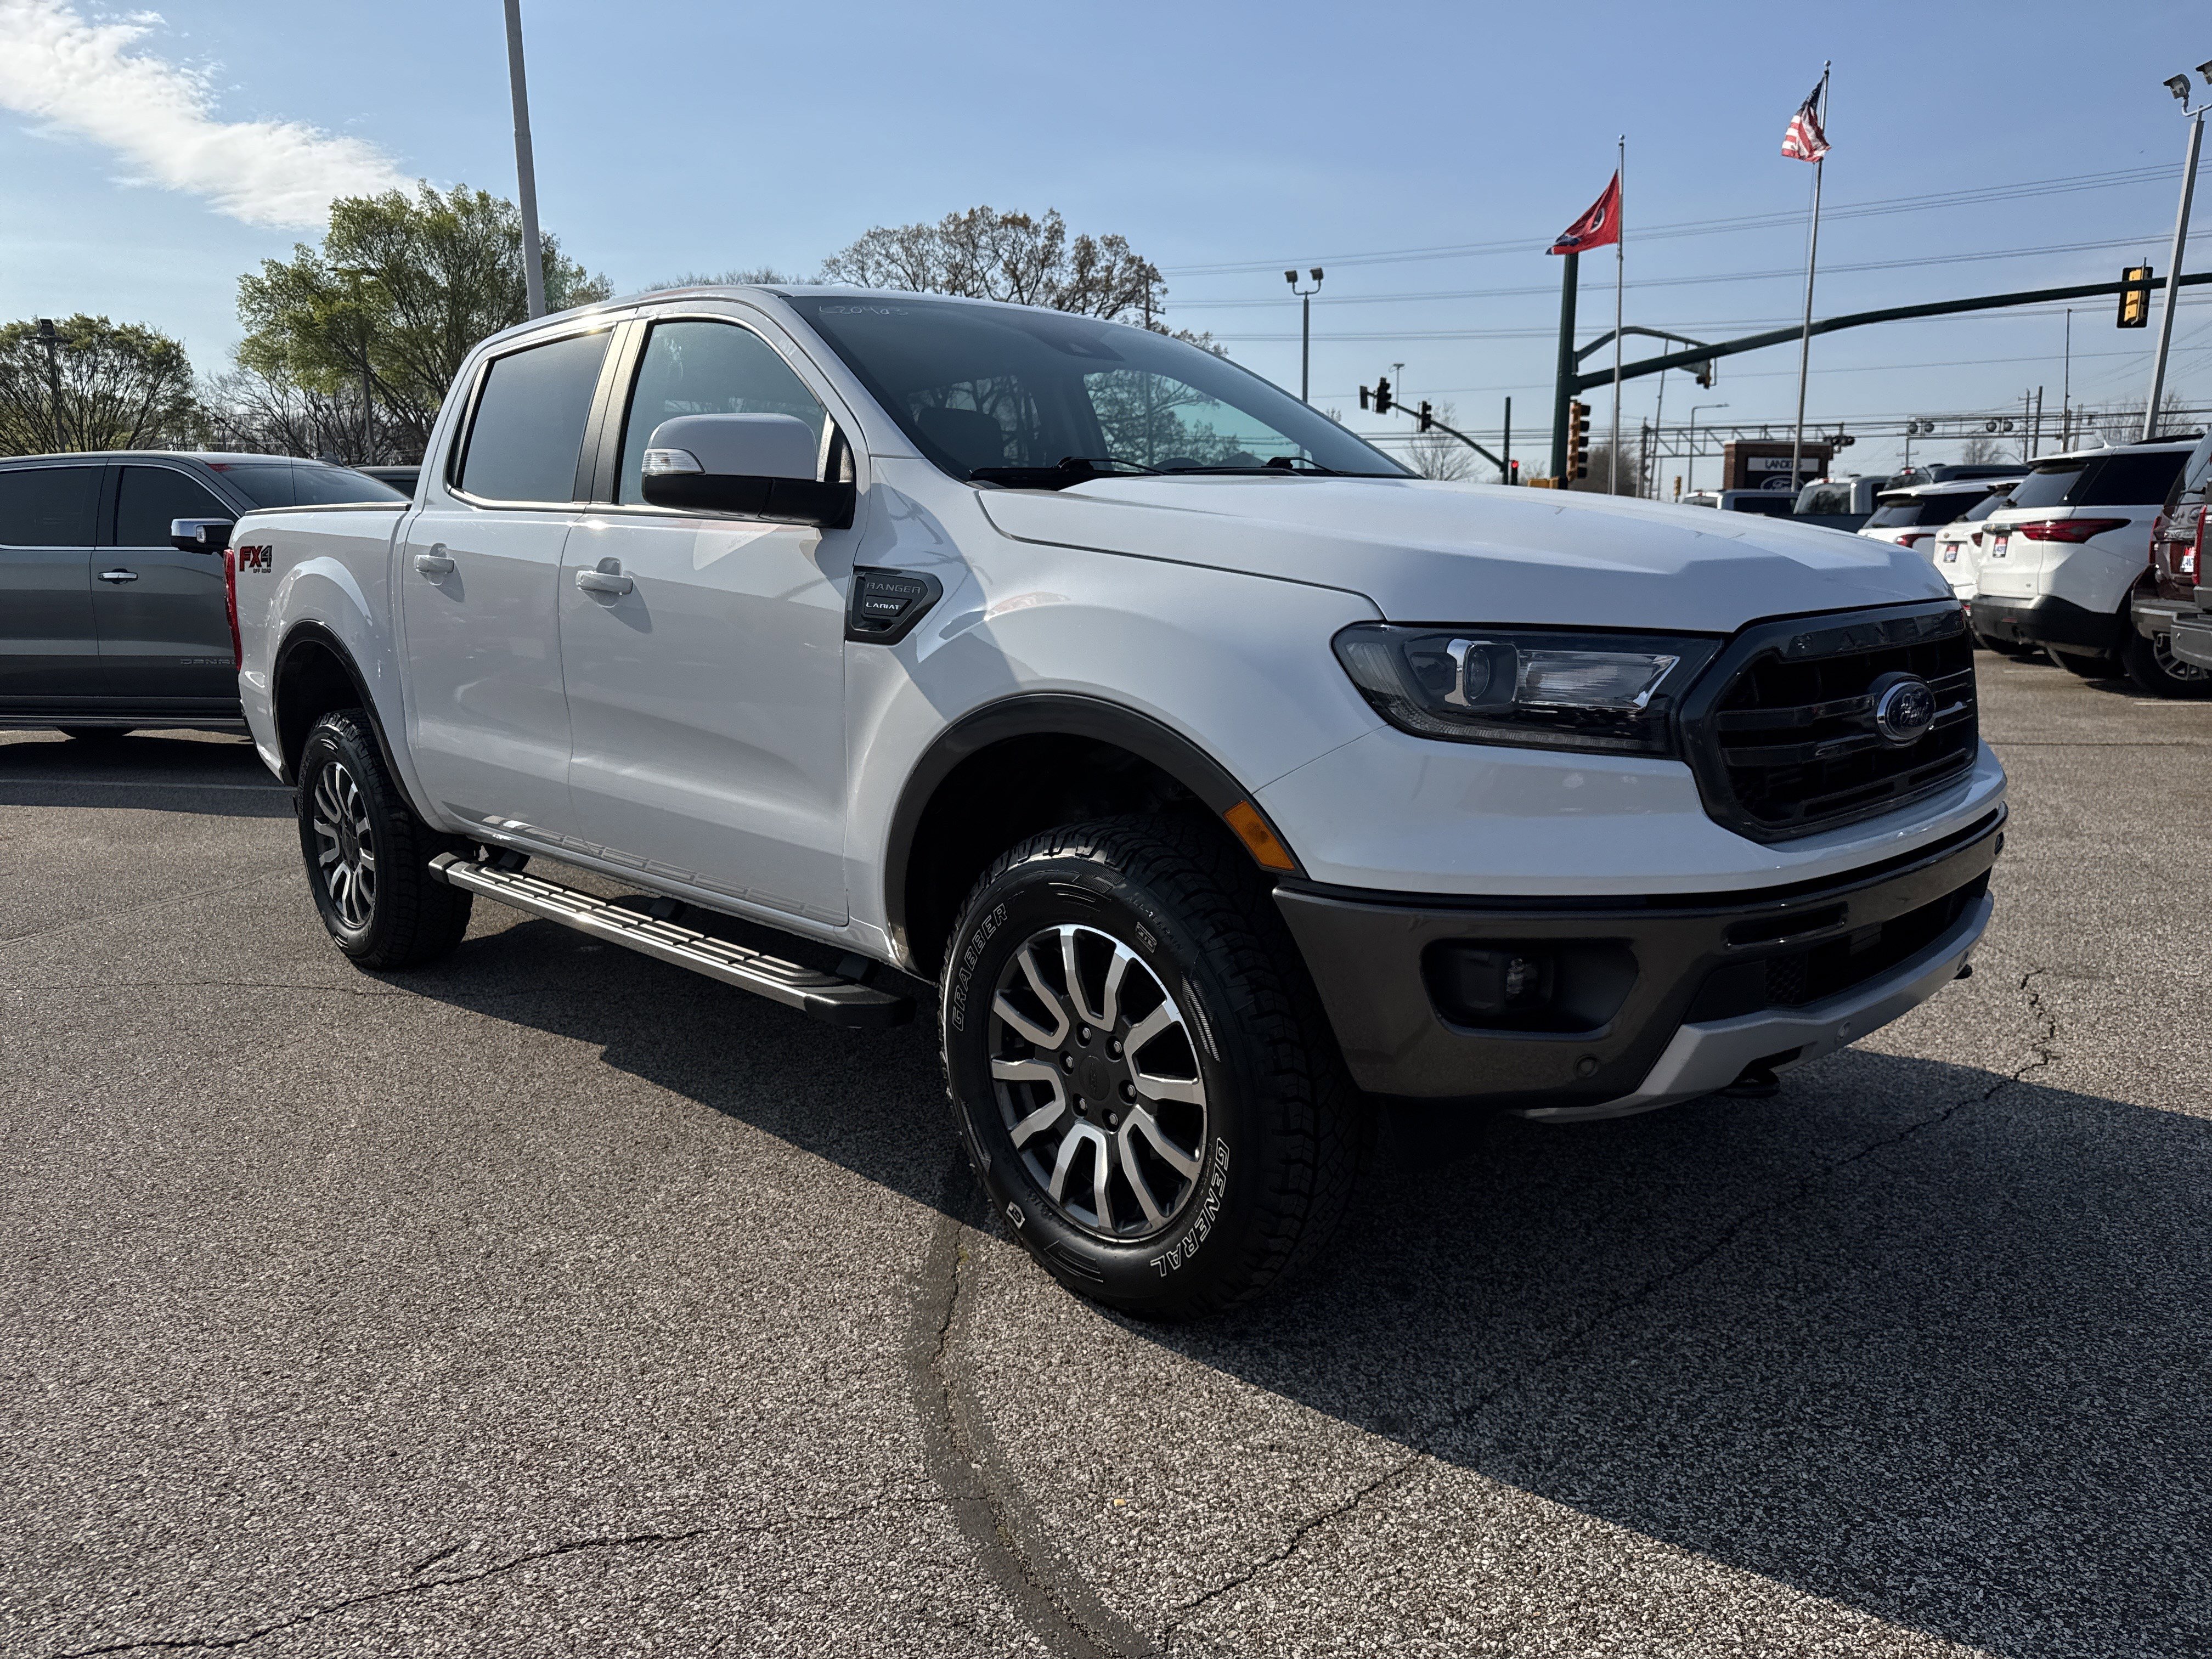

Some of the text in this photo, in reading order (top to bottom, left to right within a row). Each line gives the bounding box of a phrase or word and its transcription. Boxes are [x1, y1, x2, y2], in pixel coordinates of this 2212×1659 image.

[239, 545, 273, 572] FX4
[866, 582, 922, 594] RANGER
[866, 602, 901, 610] LARIAT
[952, 902, 1008, 1032] GRABBER
[1150, 1137, 1230, 1278] GENERAL
